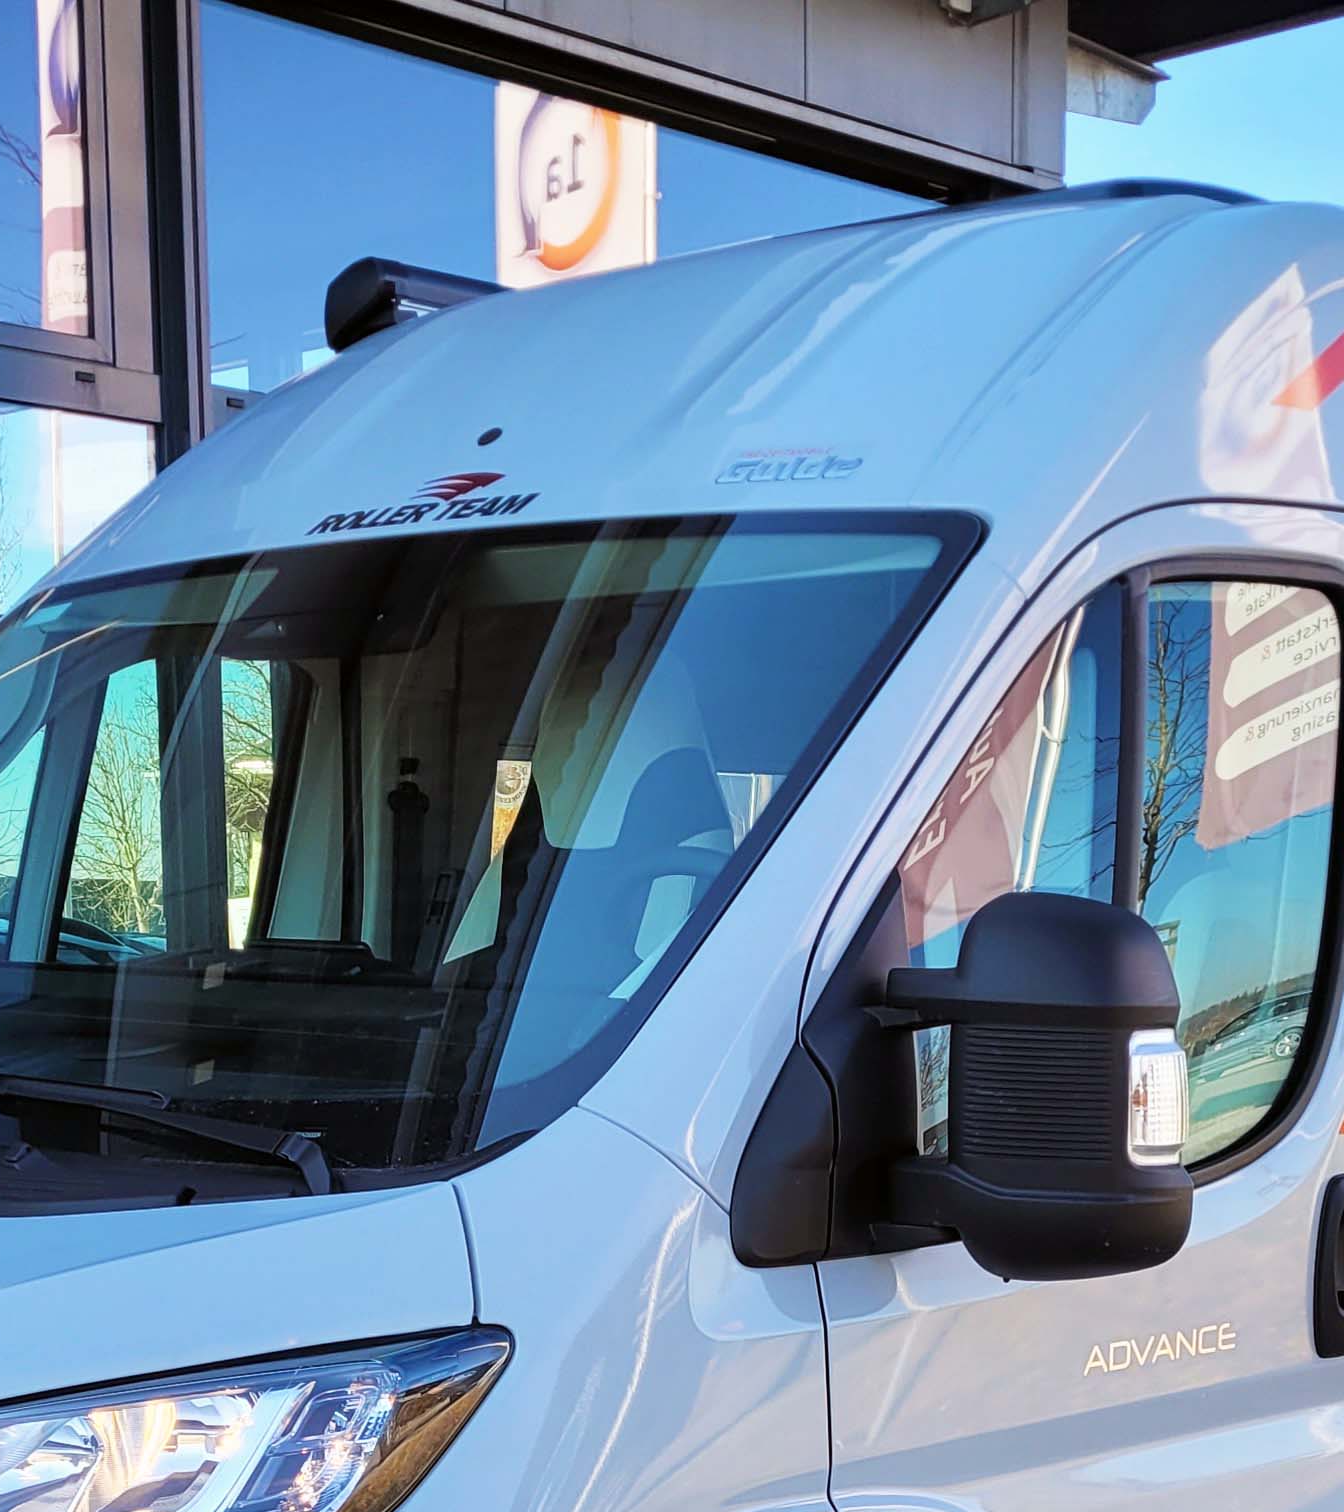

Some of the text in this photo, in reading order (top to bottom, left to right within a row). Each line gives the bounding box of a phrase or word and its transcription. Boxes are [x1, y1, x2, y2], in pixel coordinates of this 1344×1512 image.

[305, 493, 542, 536] ROLLER TEAM
[1083, 1322, 1237, 1377] ADVANCE
